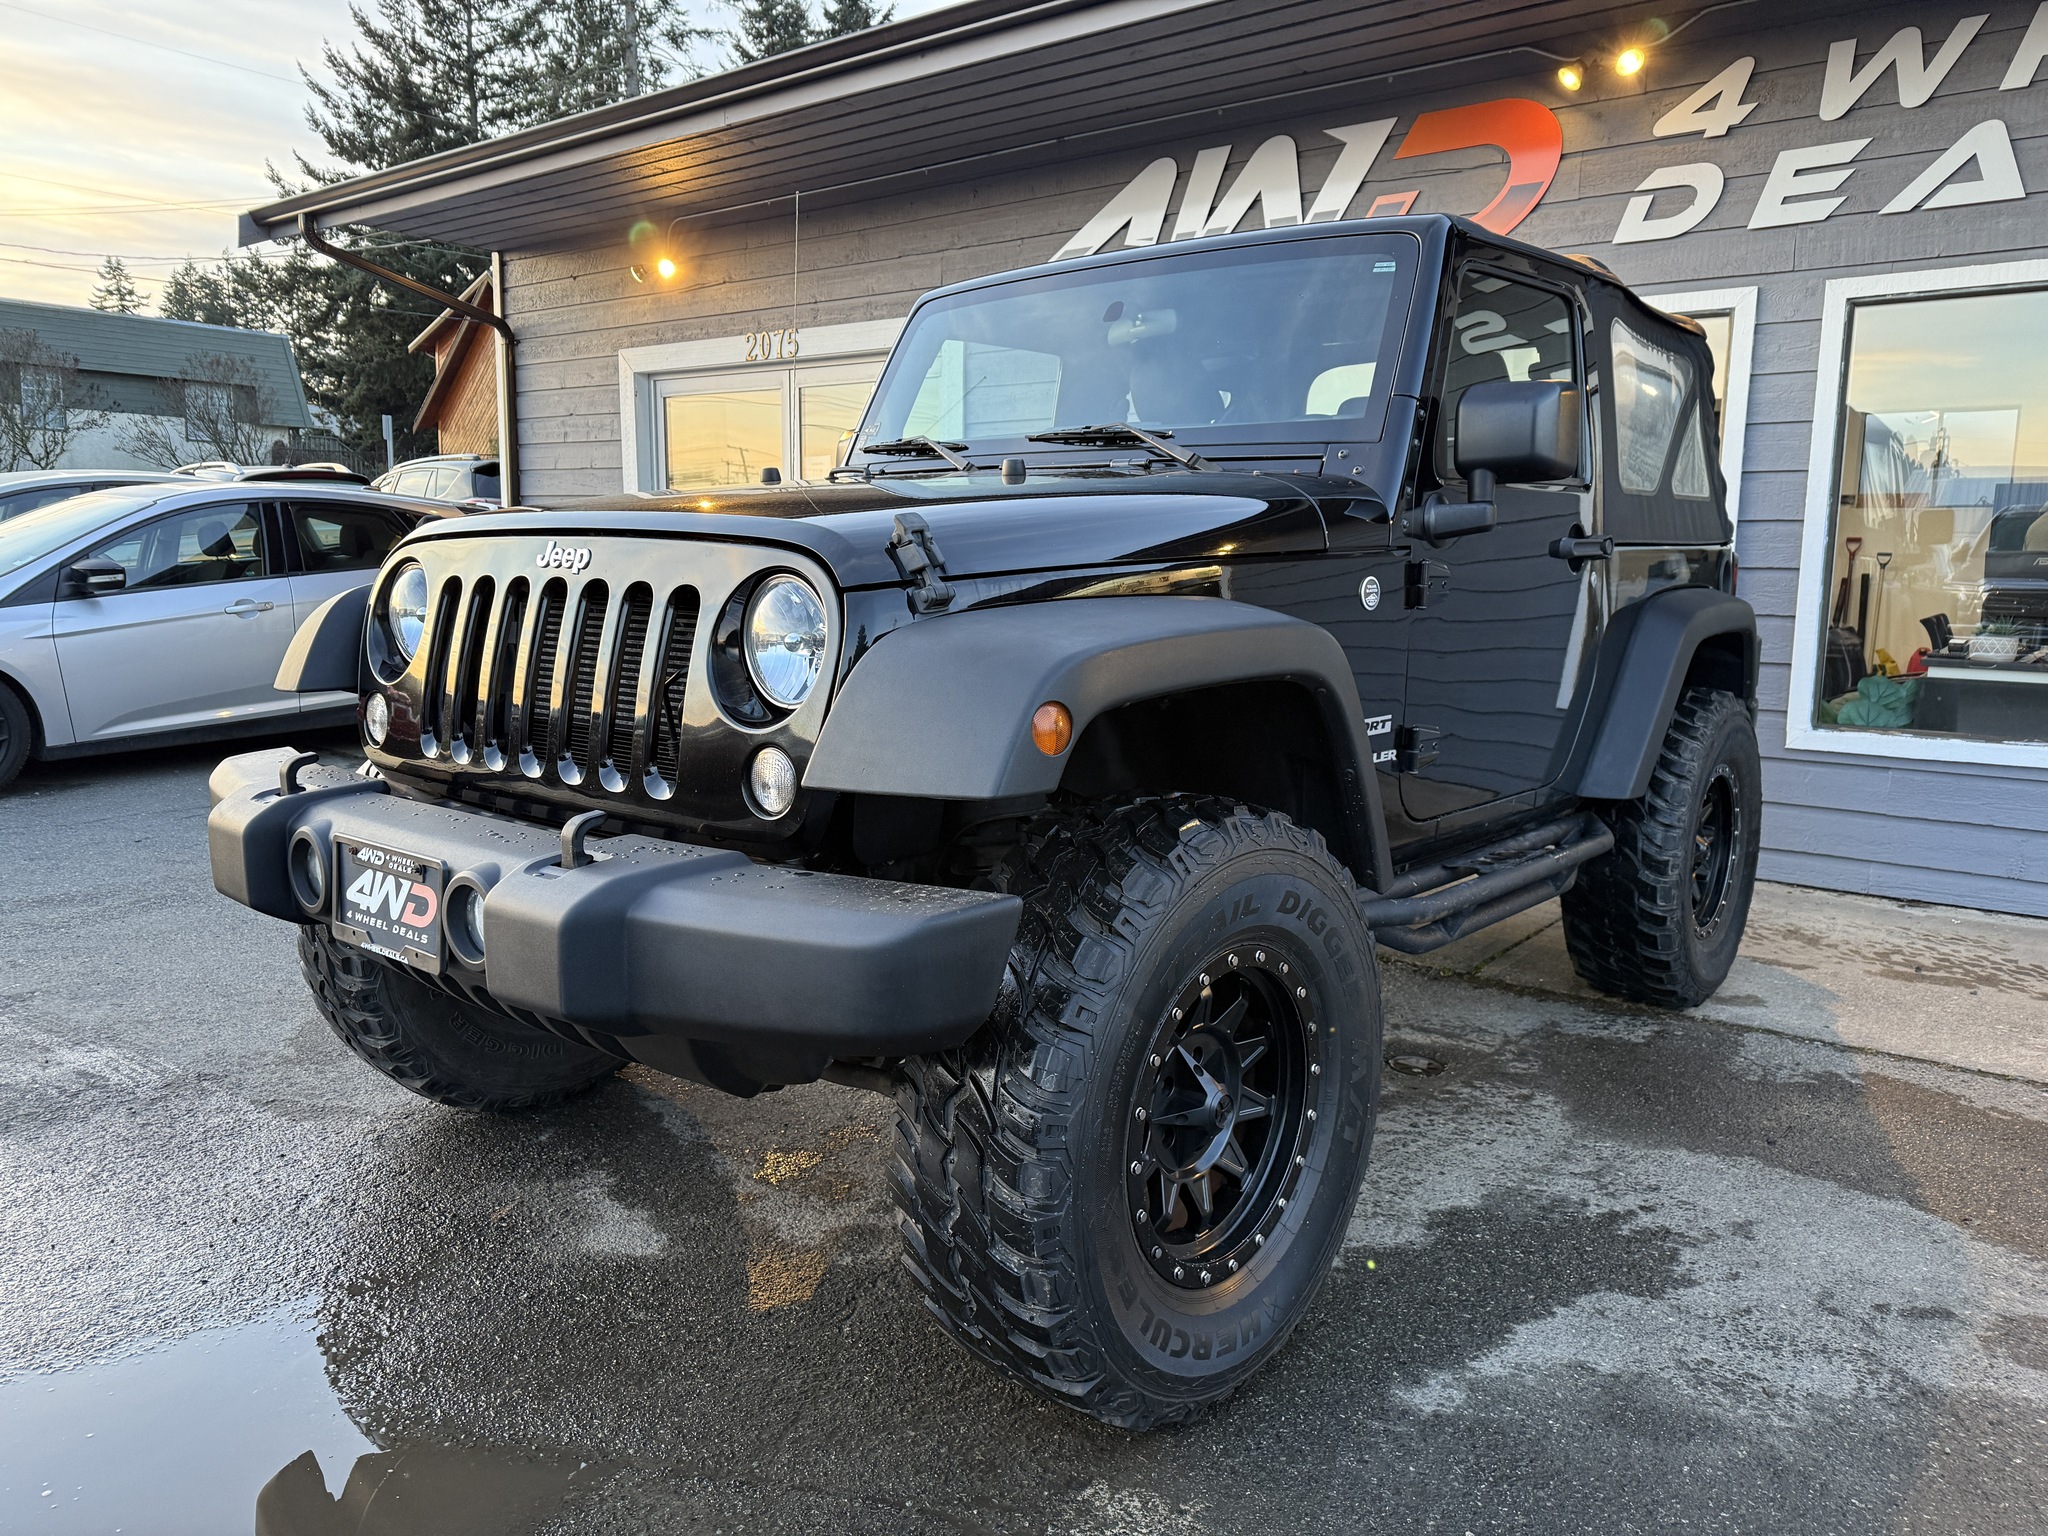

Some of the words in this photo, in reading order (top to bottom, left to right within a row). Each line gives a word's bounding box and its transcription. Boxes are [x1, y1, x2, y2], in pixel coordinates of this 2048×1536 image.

[1653, 56, 1759, 138] 4
[745, 328, 799, 362] 2075
[536, 540, 592, 575] Jeep
[356, 846, 385, 866] 4WD
[346, 868, 438, 928] 4WD
[346, 910, 353, 919] 4
[355, 911, 388, 931] WHEEL
[392, 924, 429, 944] DEALS
